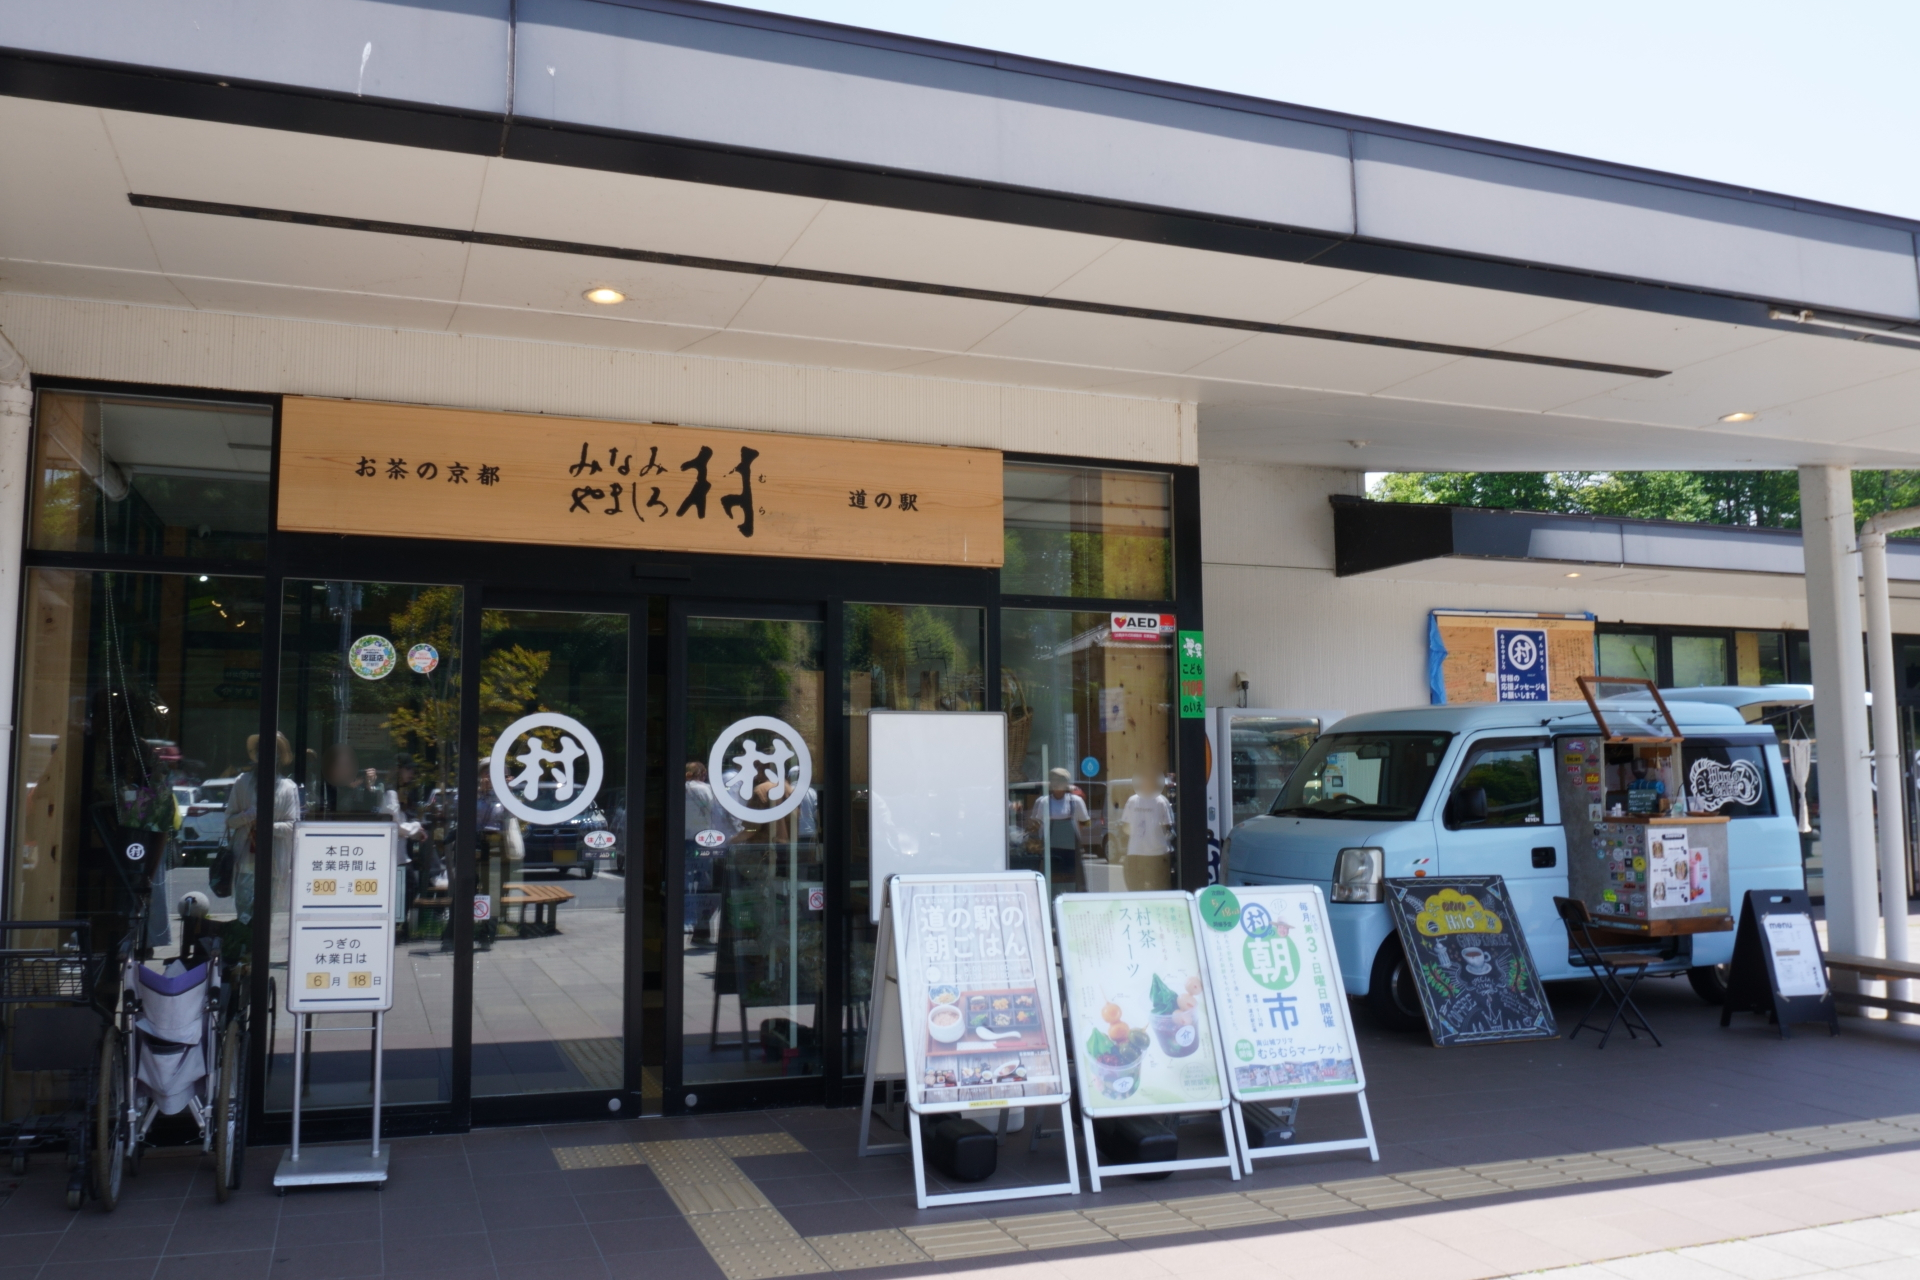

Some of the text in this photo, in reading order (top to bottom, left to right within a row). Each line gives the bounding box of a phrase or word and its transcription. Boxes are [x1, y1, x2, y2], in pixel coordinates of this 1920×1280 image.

[568, 441, 669, 478] みなみ
[354, 455, 501, 487] お茶の京都
[675, 445, 760, 538] 村
[848, 488, 919, 512] 道の駅
[568, 481, 669, 523] やましろ
[1126, 617, 1158, 628] AED
[361, 654, 384, 662] 認証店
[1513, 641, 1532, 664] 村
[1537, 634, 1545, 671] がんばろう
[1182, 663, 1203, 675] こども
[1500, 674, 1520, 683] 皆様の
[1181, 680, 1204, 697] 110番
[1182, 702, 1203, 713] のいえ
[508, 736, 585, 802] 村
[725, 738, 795, 801] 村
[129, 844, 143, 859] 村
[325, 845, 364, 857] 本日の
[311, 860, 377, 872] 営業時間は
[313, 880, 336, 893] 9:00
[355, 880, 378, 893] 6:00
[920, 904, 1024, 932] 道の駅の
[1445, 914, 1475, 931] Hilo
[1135, 907, 1157, 949] 村茶
[322, 938, 361, 949] つぎの
[923, 931, 1027, 961] 朝ごはん
[1118, 907, 1140, 978] スイーツ
[315, 953, 367, 965] 休業日は
[313, 974, 382, 987] 6 月 18 日
[1447, 993, 1478, 1028] COFFEE
[1257, 1043, 1343, 1060] むらむらマーケット
